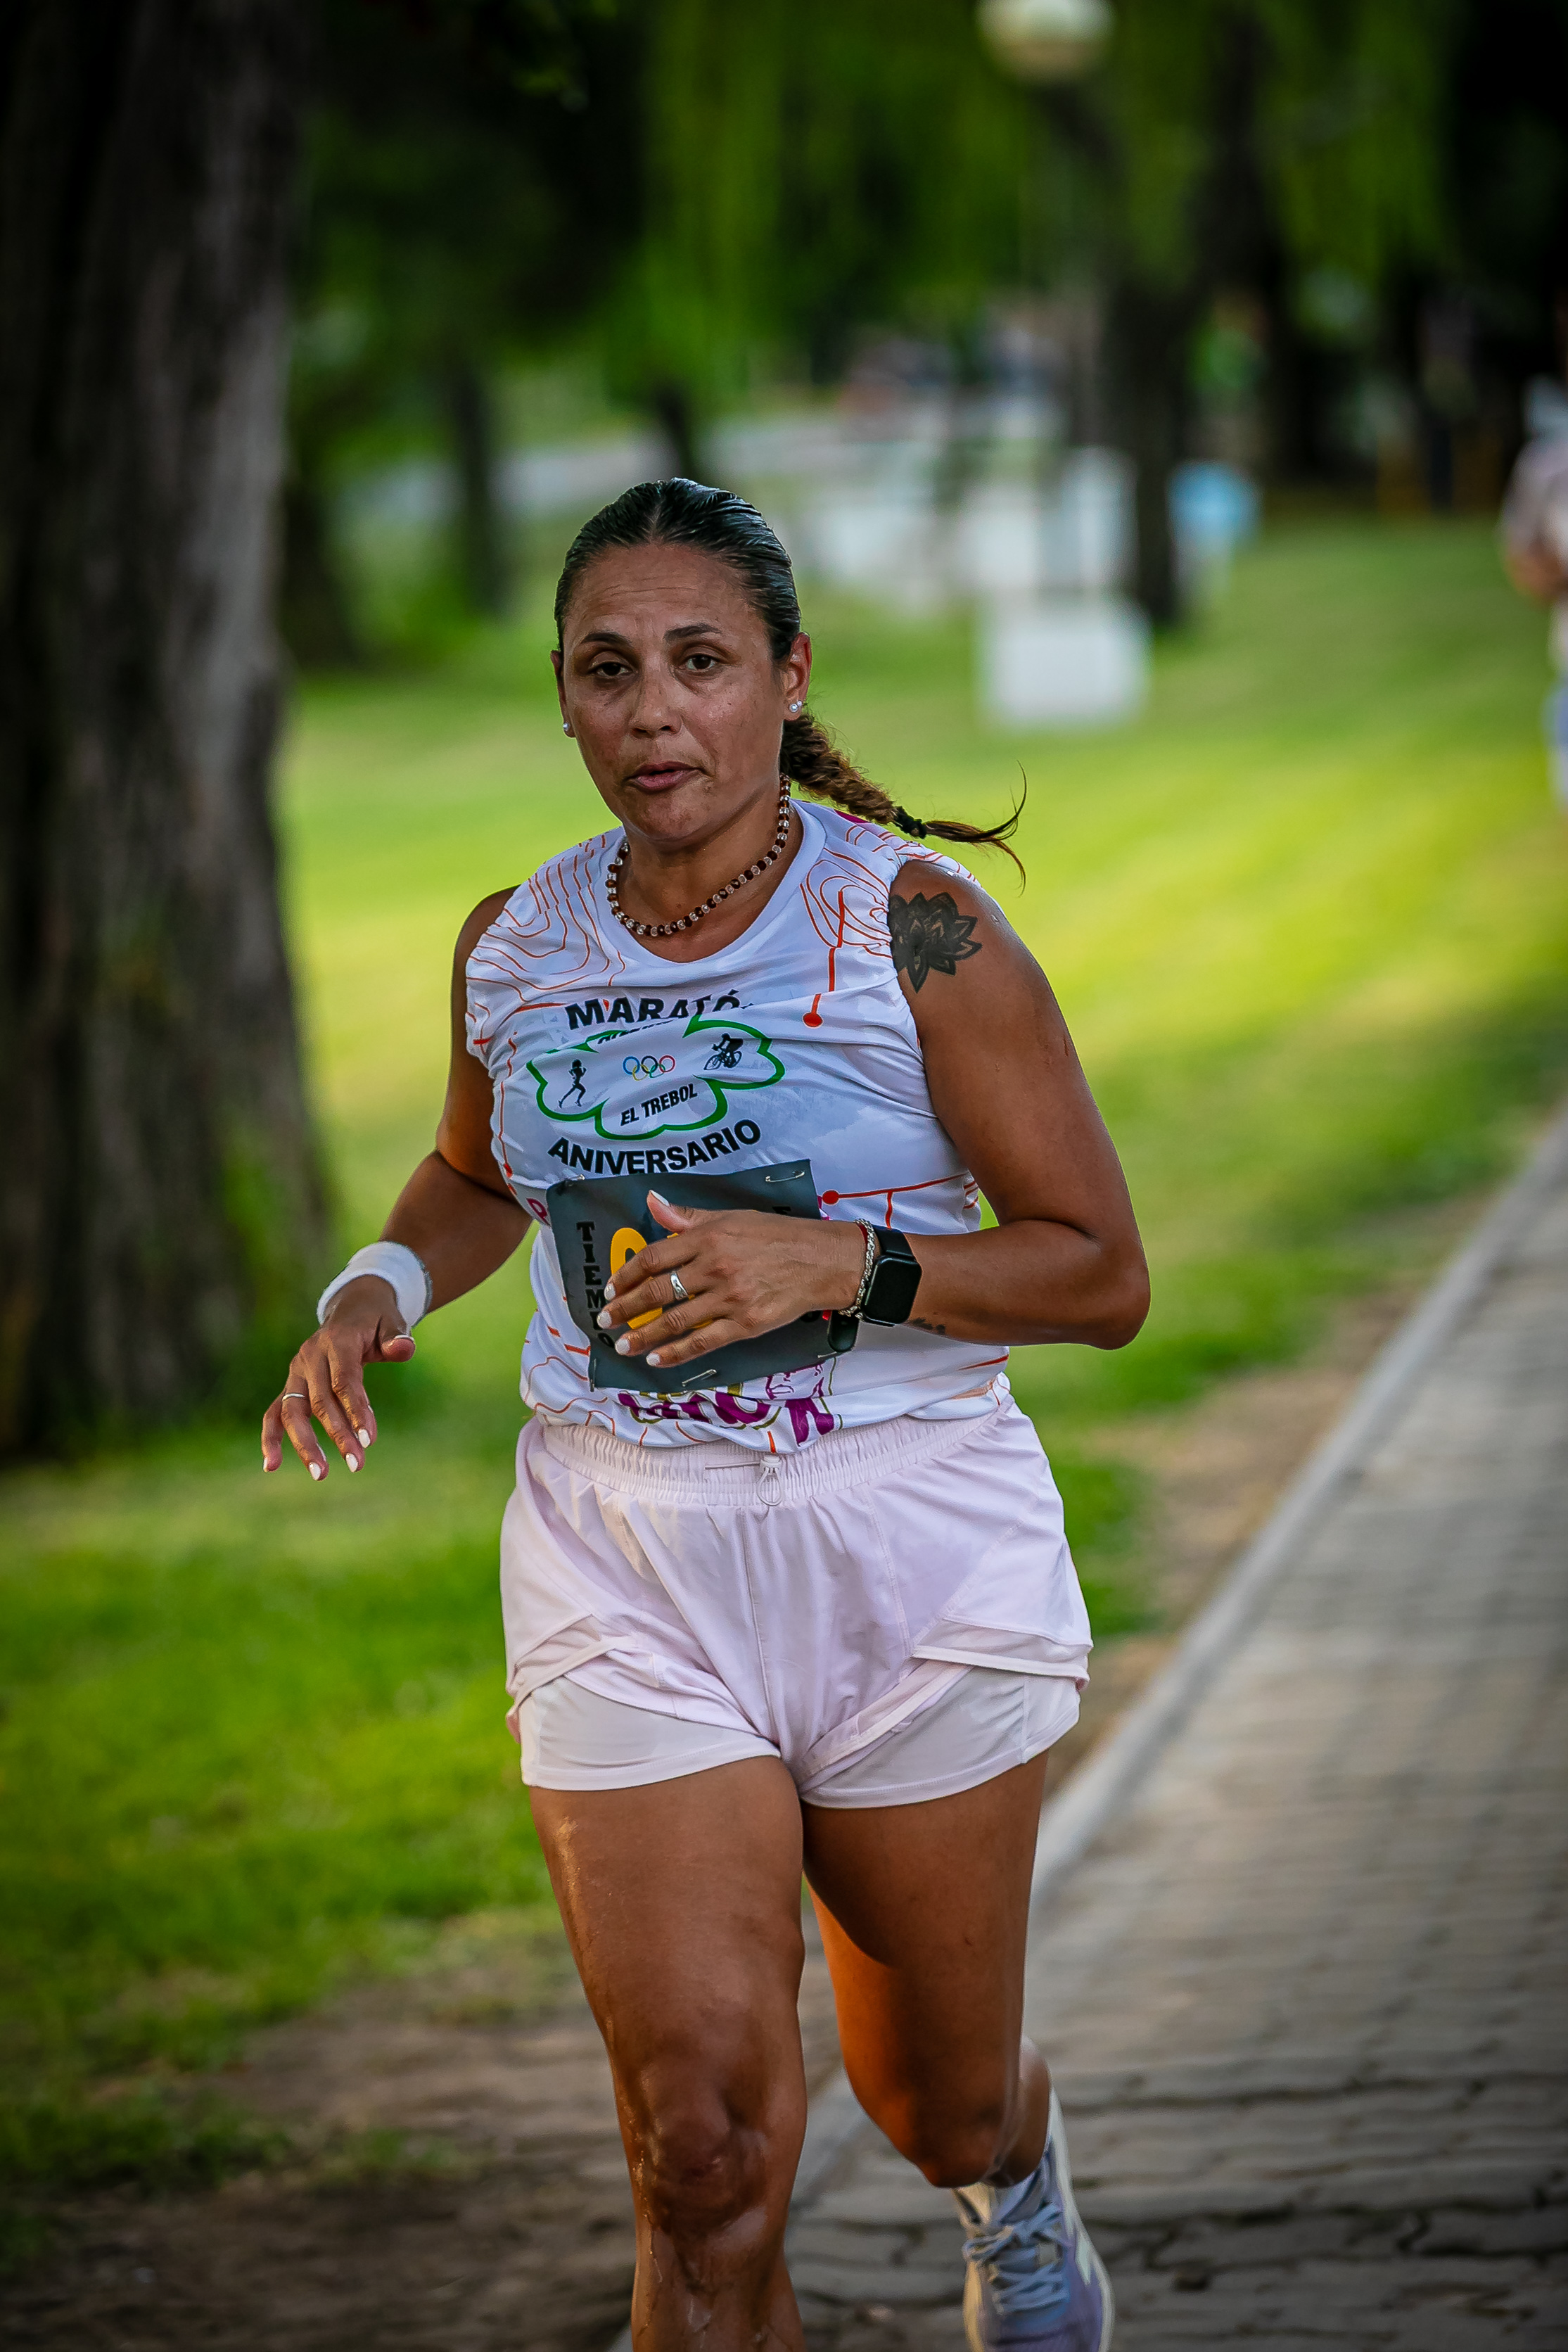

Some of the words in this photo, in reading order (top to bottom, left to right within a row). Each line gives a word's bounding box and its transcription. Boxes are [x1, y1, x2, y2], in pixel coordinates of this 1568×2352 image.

[565, 989, 753, 1030] MARATÓ
[620, 1107, 639, 1126] EL
[641, 1083, 698, 1119] TREBOL
[547, 1119, 761, 1175] ANIVERSARIO
